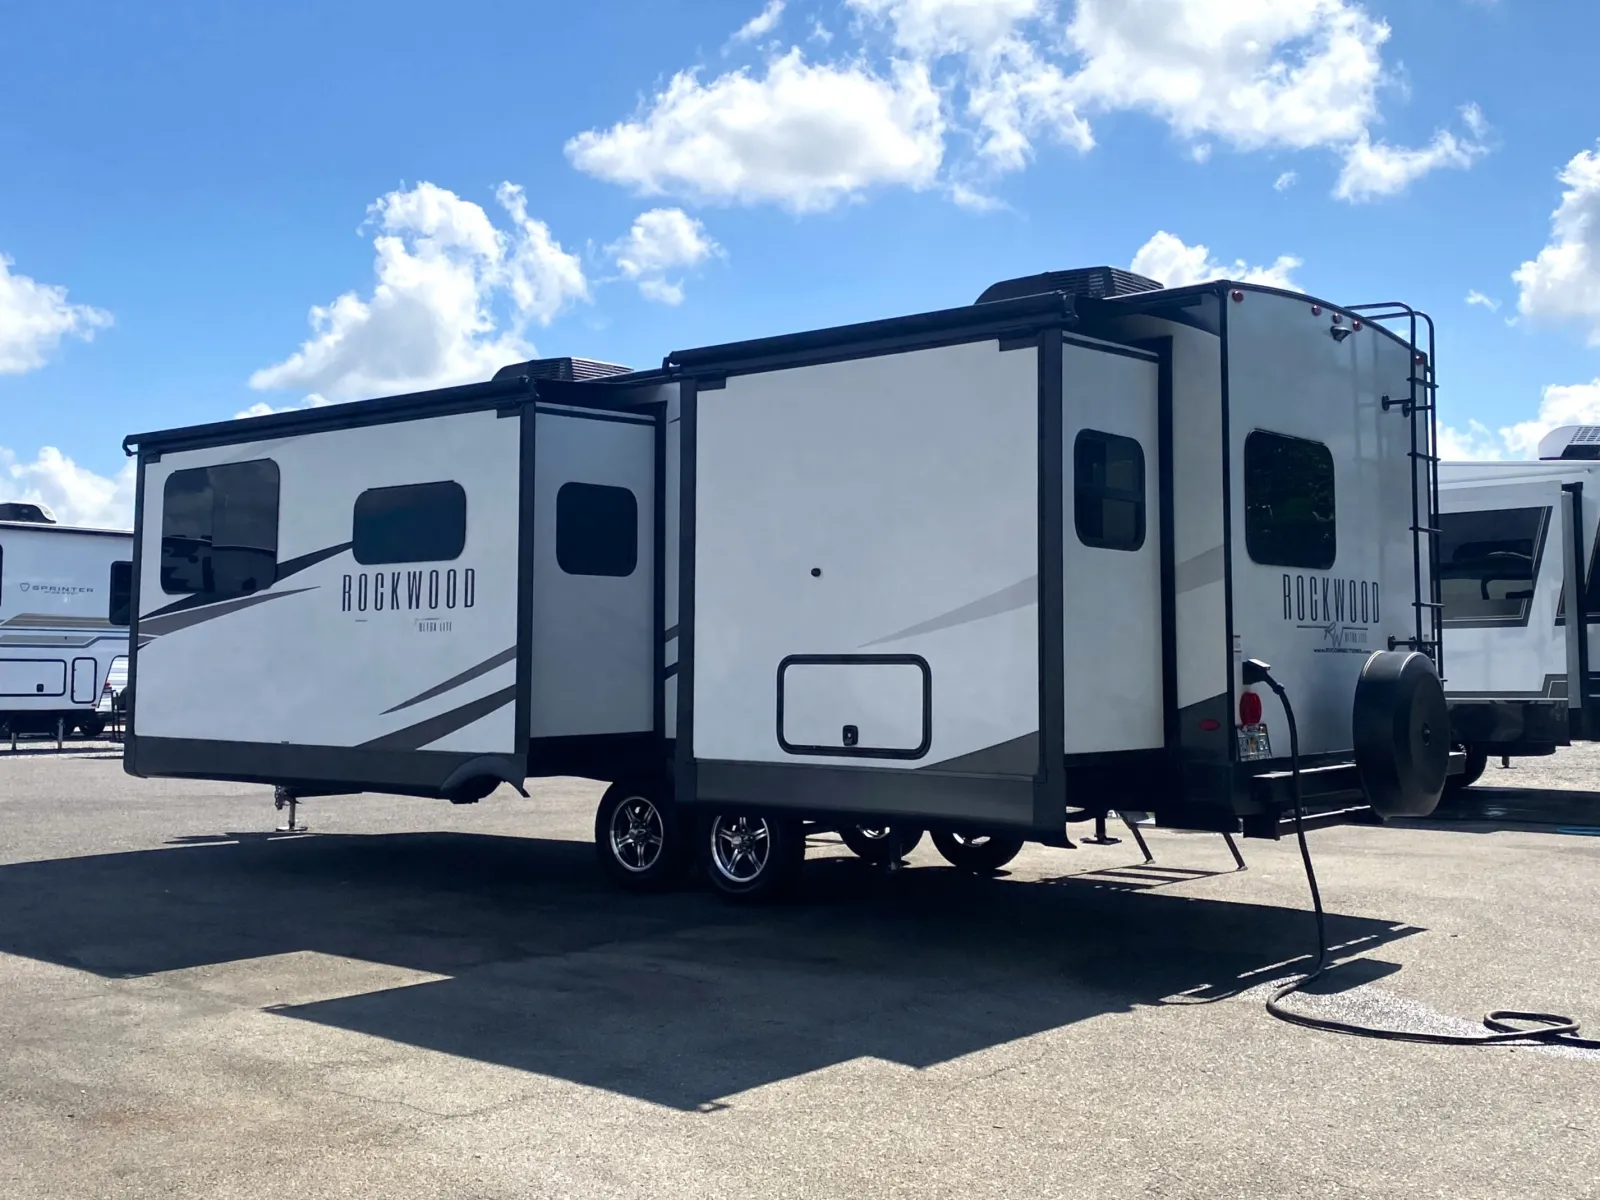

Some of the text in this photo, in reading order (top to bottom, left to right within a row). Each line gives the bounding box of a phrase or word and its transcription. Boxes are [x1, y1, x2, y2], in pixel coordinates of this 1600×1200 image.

[31, 585, 94, 593] SPRINTER
[342, 568, 475, 612] ROCKWOOD
[1283, 573, 1380, 624] ROCKWOOD
